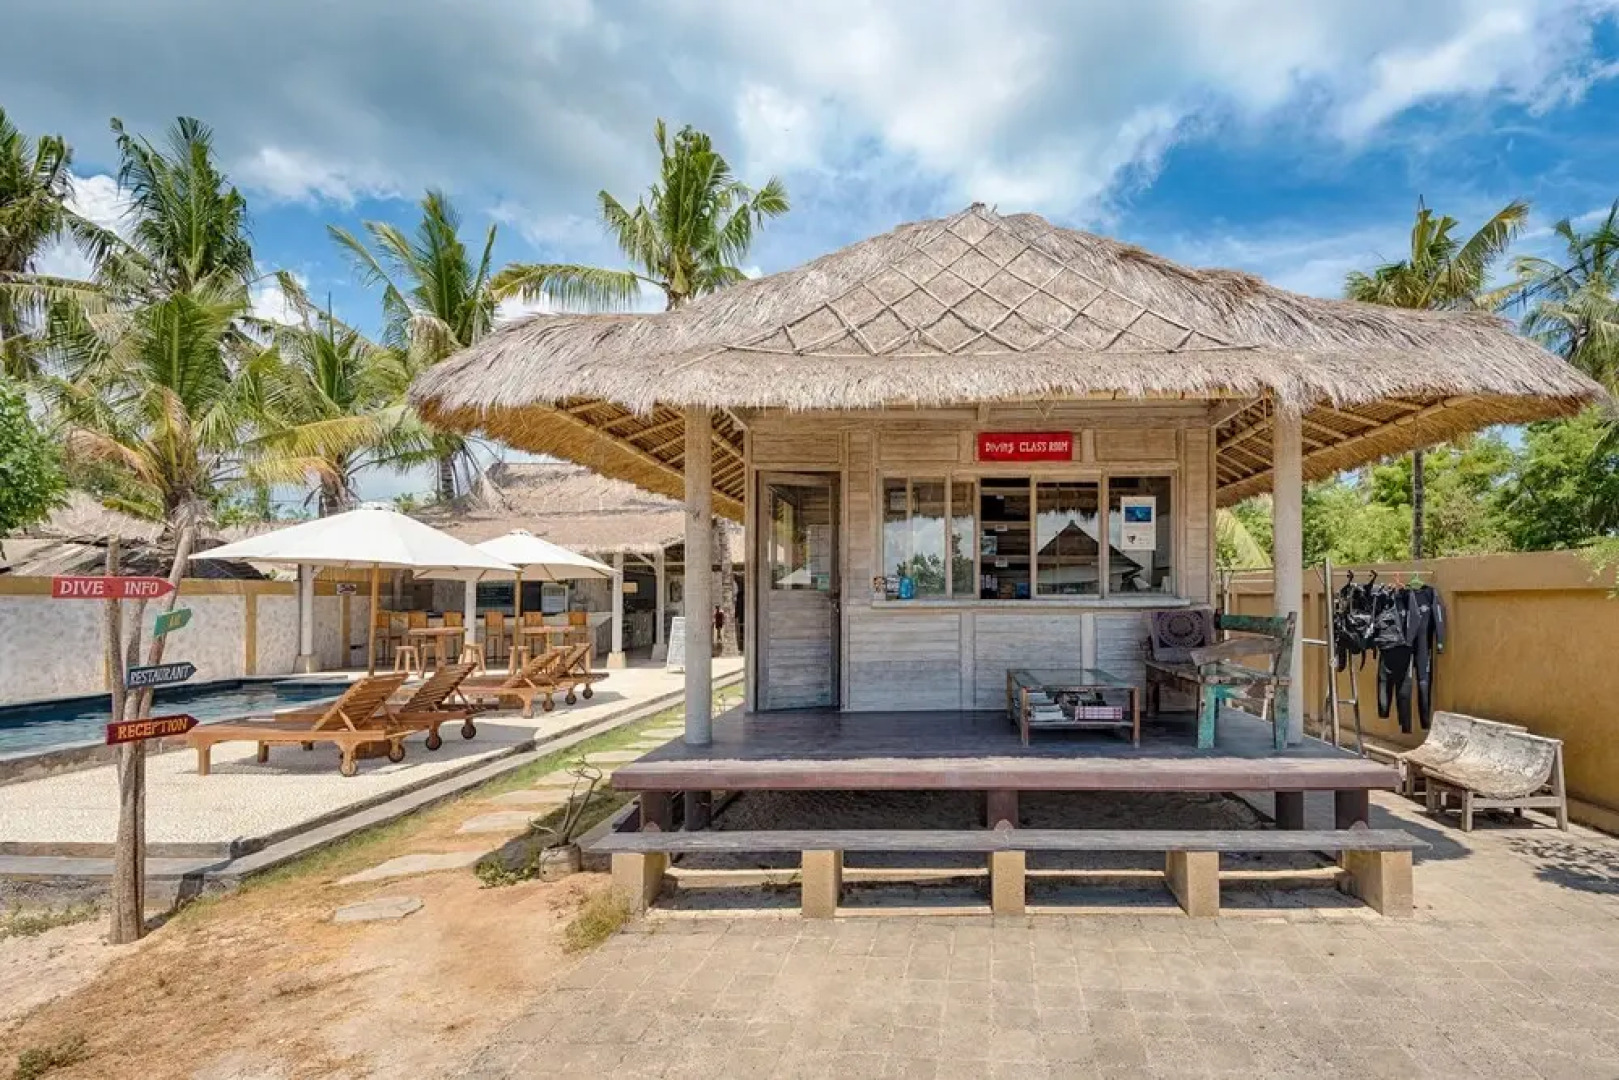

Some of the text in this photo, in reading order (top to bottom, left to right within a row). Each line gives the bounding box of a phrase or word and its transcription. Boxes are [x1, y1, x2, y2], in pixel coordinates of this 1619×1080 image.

[1020, 442, 1047, 453] CLASS
[60, 581, 159, 595] DIVE INFO
[131, 666, 189, 683] RESTAURANT
[118, 719, 187, 739] RECEPTION
